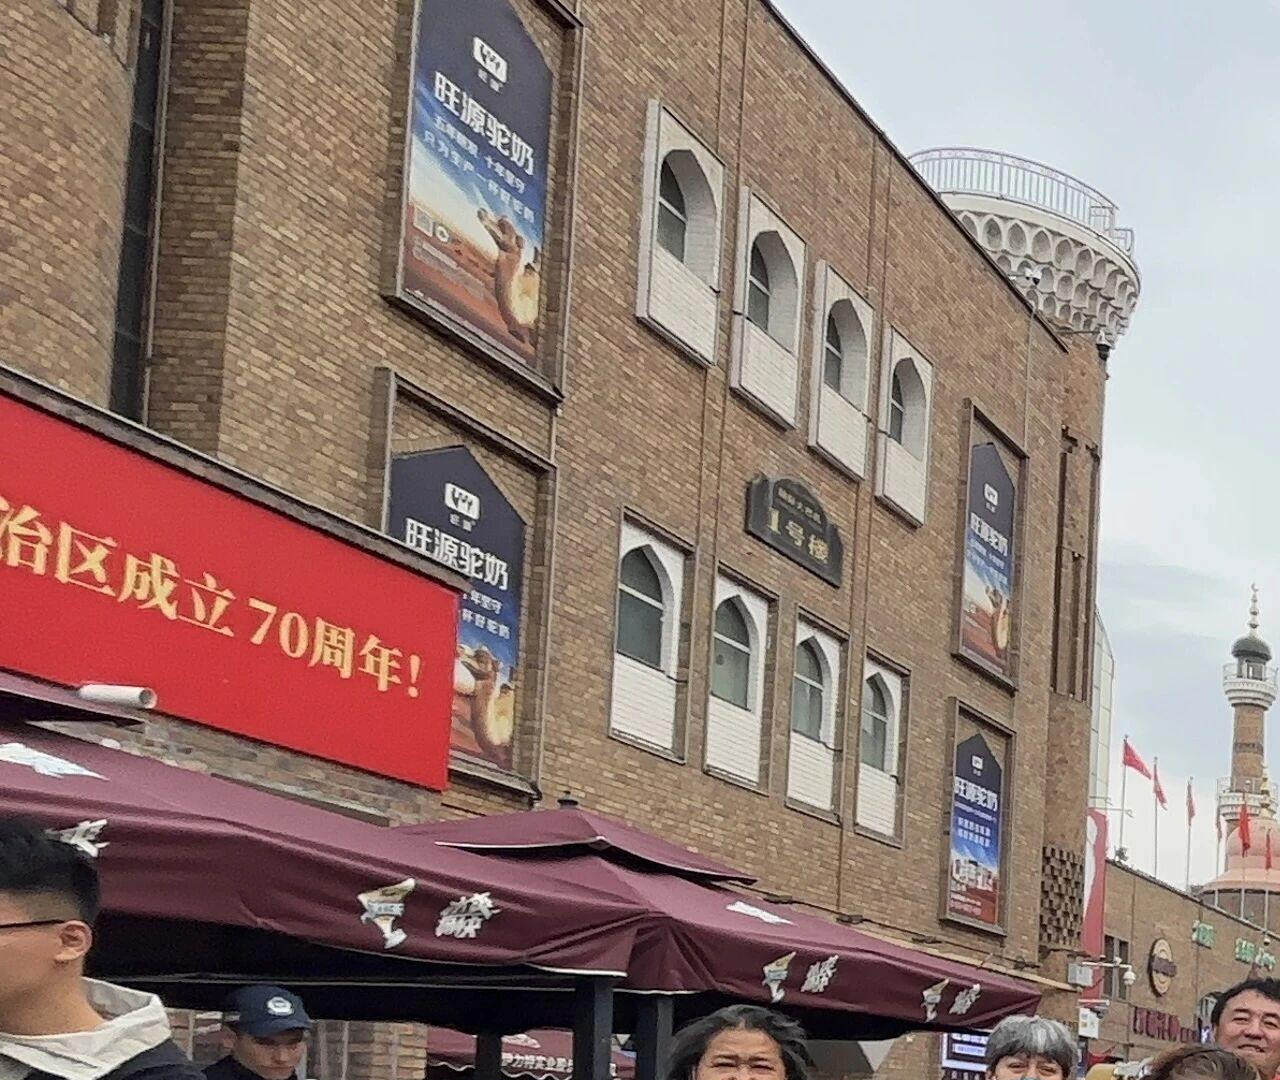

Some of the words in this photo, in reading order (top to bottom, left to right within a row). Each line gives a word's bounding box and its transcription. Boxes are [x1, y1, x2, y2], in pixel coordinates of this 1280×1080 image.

[435, 71, 535, 176] 旺源驼奶
[405, 518, 509, 591] 旺源驼奶
